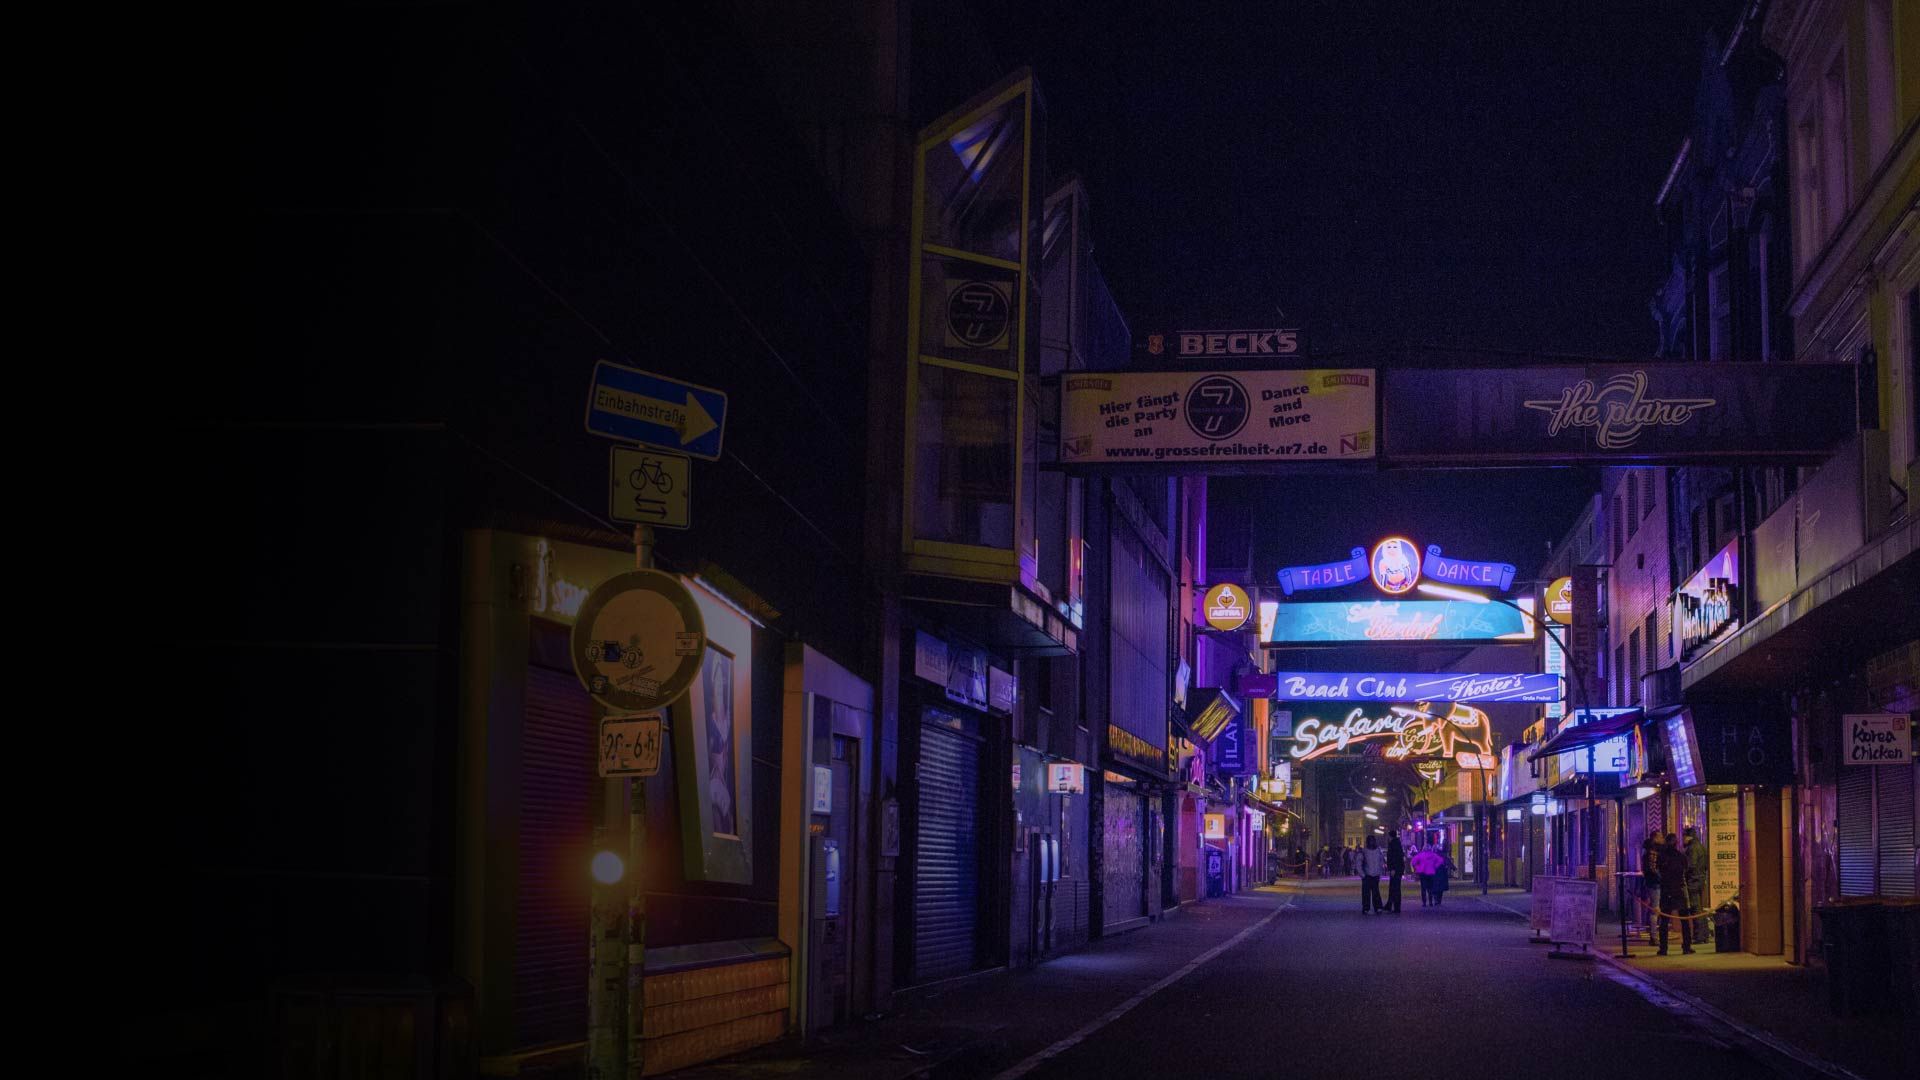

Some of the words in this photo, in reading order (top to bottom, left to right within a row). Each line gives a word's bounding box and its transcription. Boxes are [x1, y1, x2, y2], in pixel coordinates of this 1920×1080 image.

[1180, 331, 1298, 354] BECK'S
[1100, 400, 1132, 415] Hier
[1137, 391, 1180, 410] fängt
[1261, 385, 1309, 401] Dance
[597, 391, 686, 424] Einbahnstraße
[1273, 398, 1302, 413] and
[1597, 371, 1692, 448] plane
[1105, 413, 1130, 428] die
[1135, 407, 1178, 424] Party
[1269, 413, 1310, 428] More
[1134, 427, 1153, 438] an
[1301, 564, 1356, 585] TABLE
[1437, 561, 1492, 582] DANCE
[1286, 677, 1348, 698] Beach
[1356, 677, 1406, 698] Club
[1447, 676, 1521, 699] Shooter's
[1290, 708, 1406, 758] Safari
[1852, 723, 1897, 744] Korea
[1852, 743, 1903, 760] Chicken
